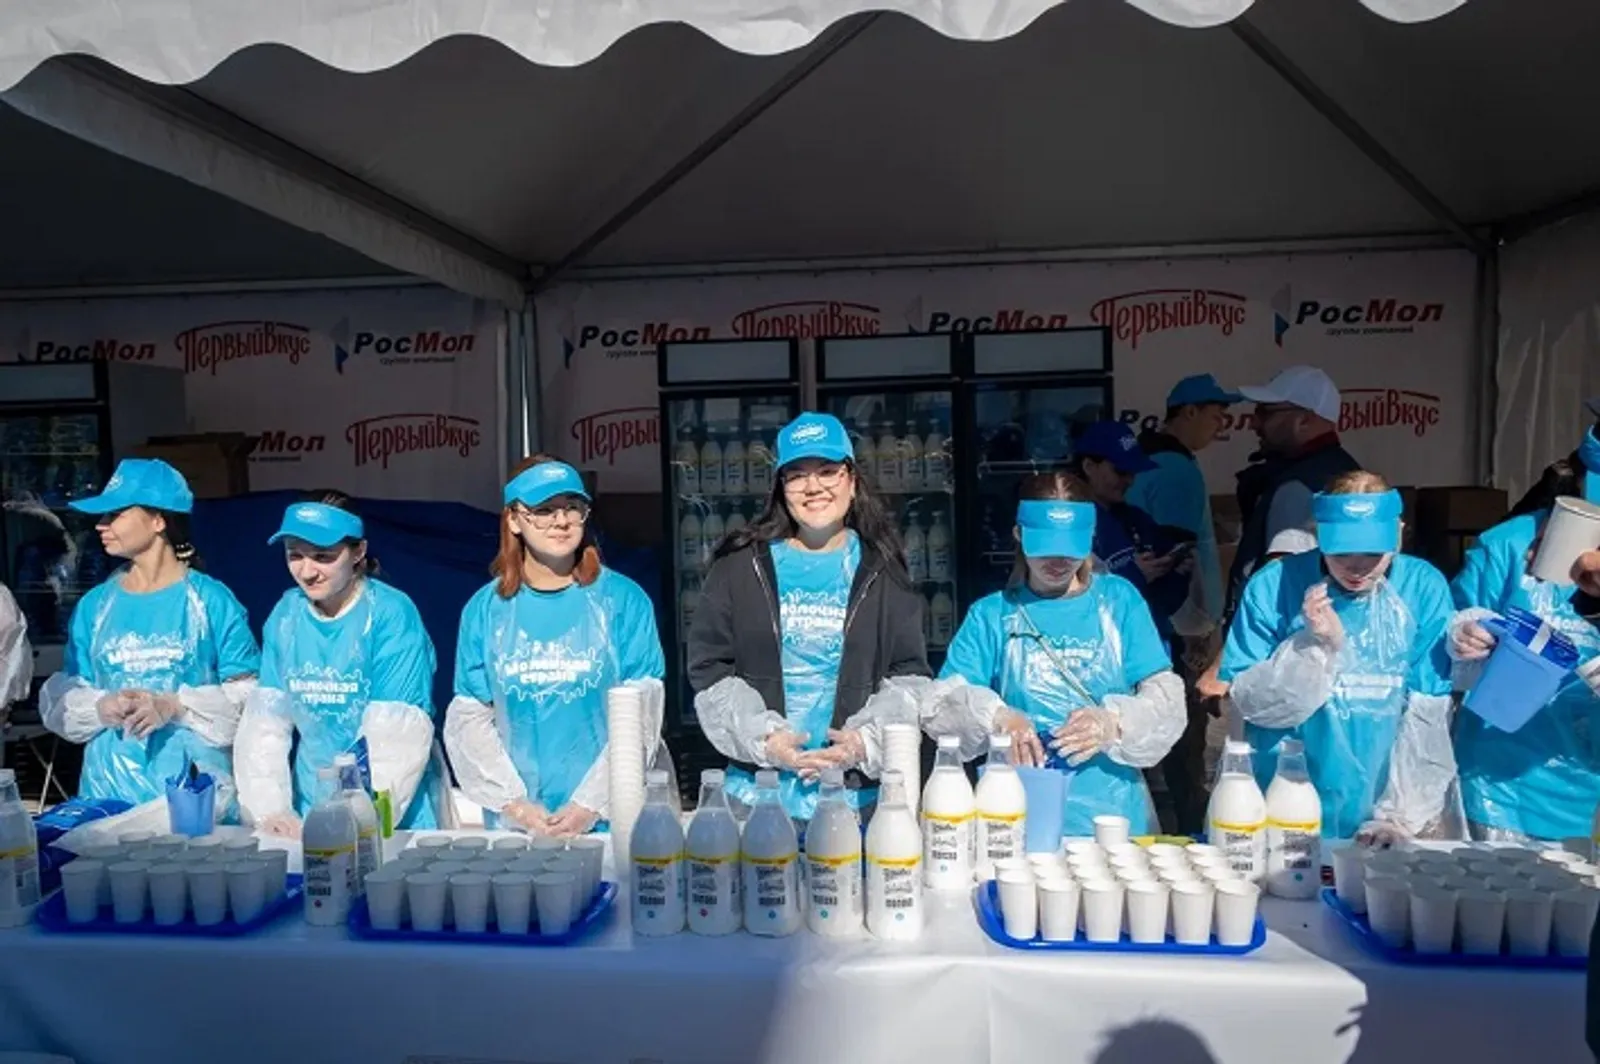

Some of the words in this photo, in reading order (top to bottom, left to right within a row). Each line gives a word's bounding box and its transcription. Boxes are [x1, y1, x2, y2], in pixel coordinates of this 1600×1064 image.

[929, 310, 1068, 334] РосМол
[1295, 299, 1444, 324] РосМол
[354, 331, 475, 354] РосМол
[579, 323, 710, 348] РосМол
[36, 339, 156, 361] РосМол
